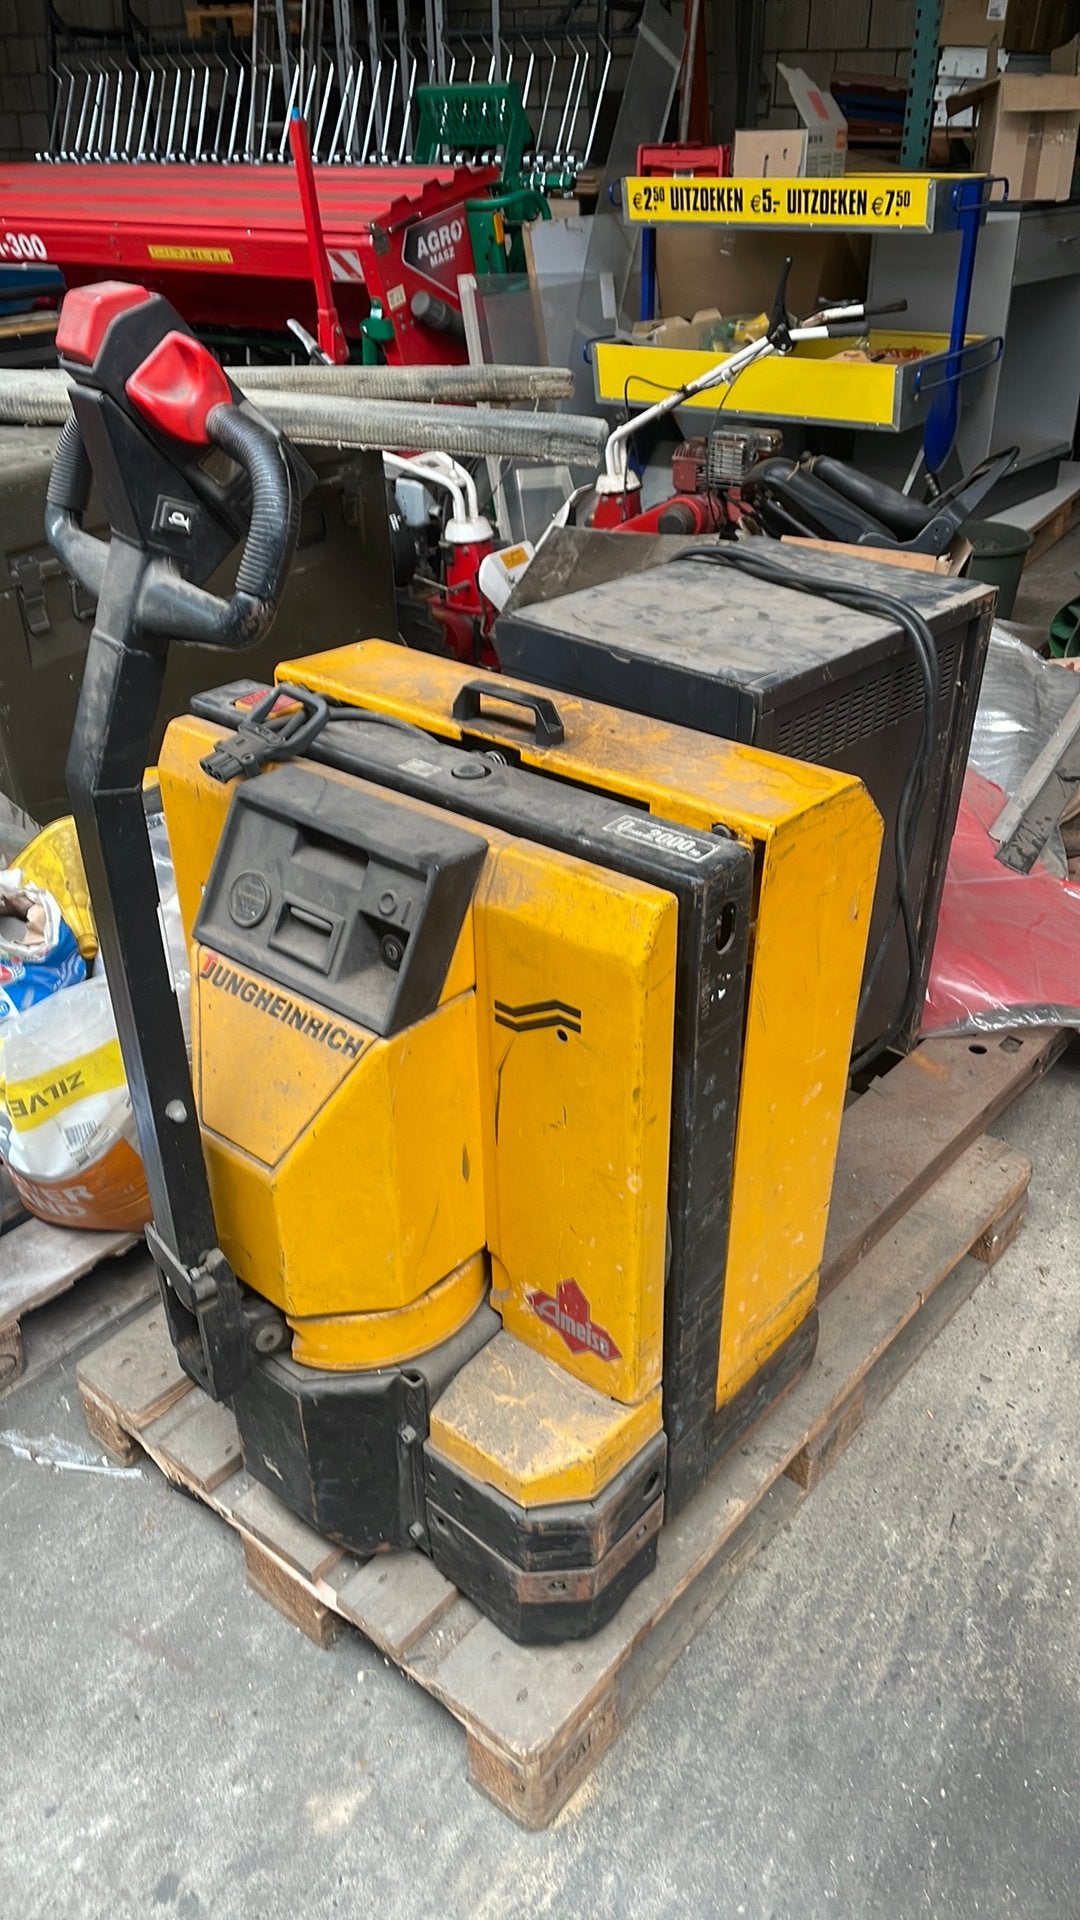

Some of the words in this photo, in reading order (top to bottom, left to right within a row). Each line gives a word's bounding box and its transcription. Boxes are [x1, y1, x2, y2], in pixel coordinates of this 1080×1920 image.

[670, 187, 743, 212] UITZOEKEN
[787, 189, 867, 216] UITZOEKEN
[0, 231, 47, 260] -300
[417, 219, 463, 260] AGRO
[645, 828, 696, 852] 2000
[200, 952, 365, 1059] JUNGHEINRICH
[6, 1070, 85, 1118] ZILVE
[534, 1300, 610, 1358] Ameise
